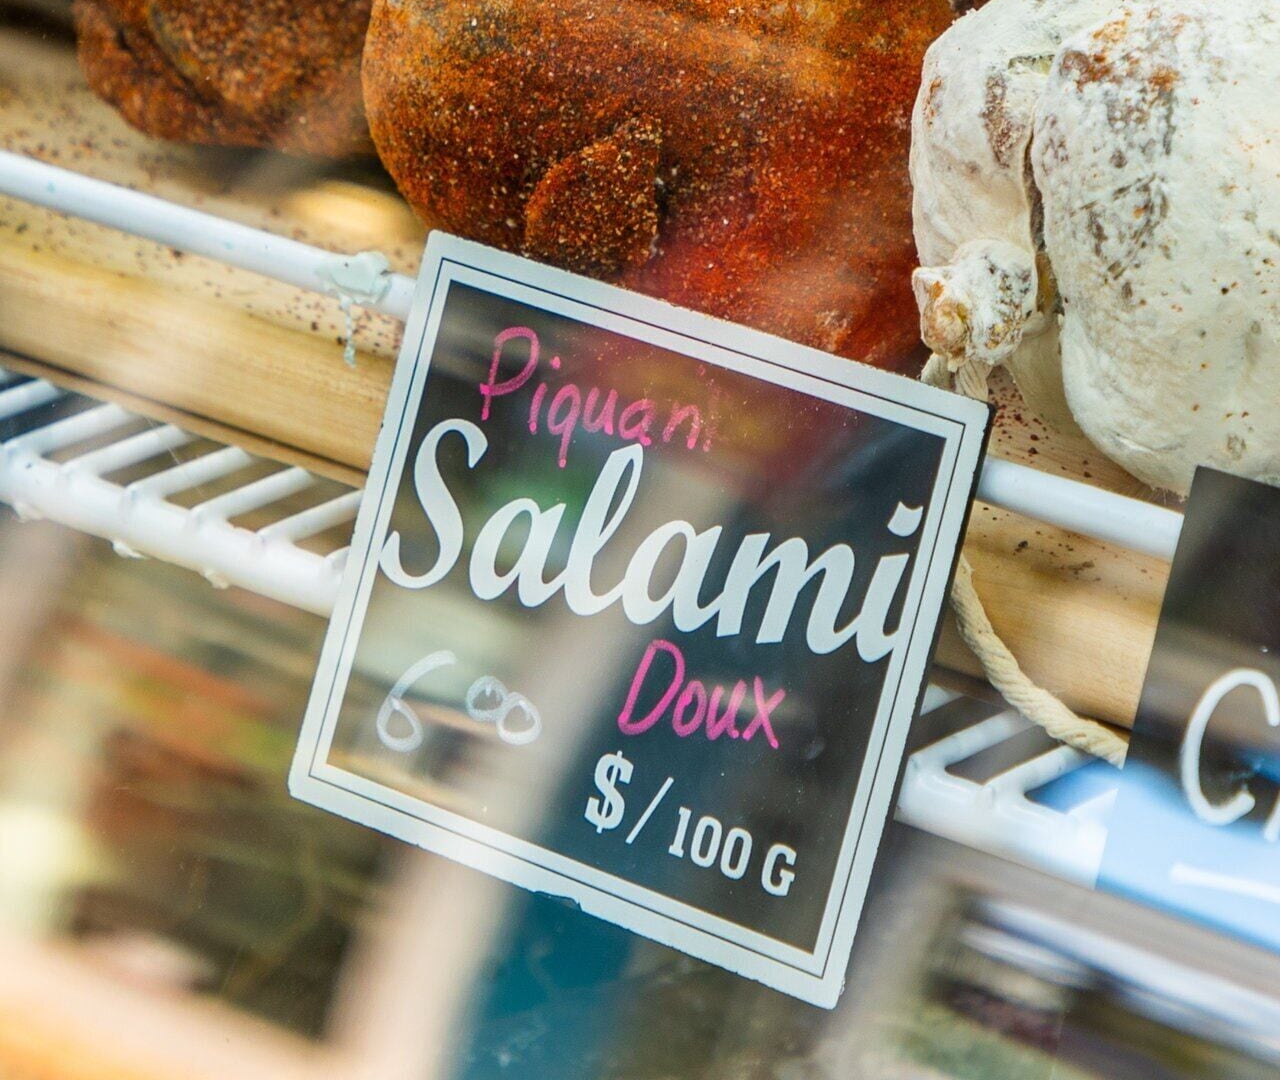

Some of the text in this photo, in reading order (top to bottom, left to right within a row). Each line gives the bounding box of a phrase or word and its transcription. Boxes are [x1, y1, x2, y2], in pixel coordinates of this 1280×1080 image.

[479, 325, 721, 469] Piquan
[378, 418, 924, 663] Salami
[618, 638, 785, 750] Doux
